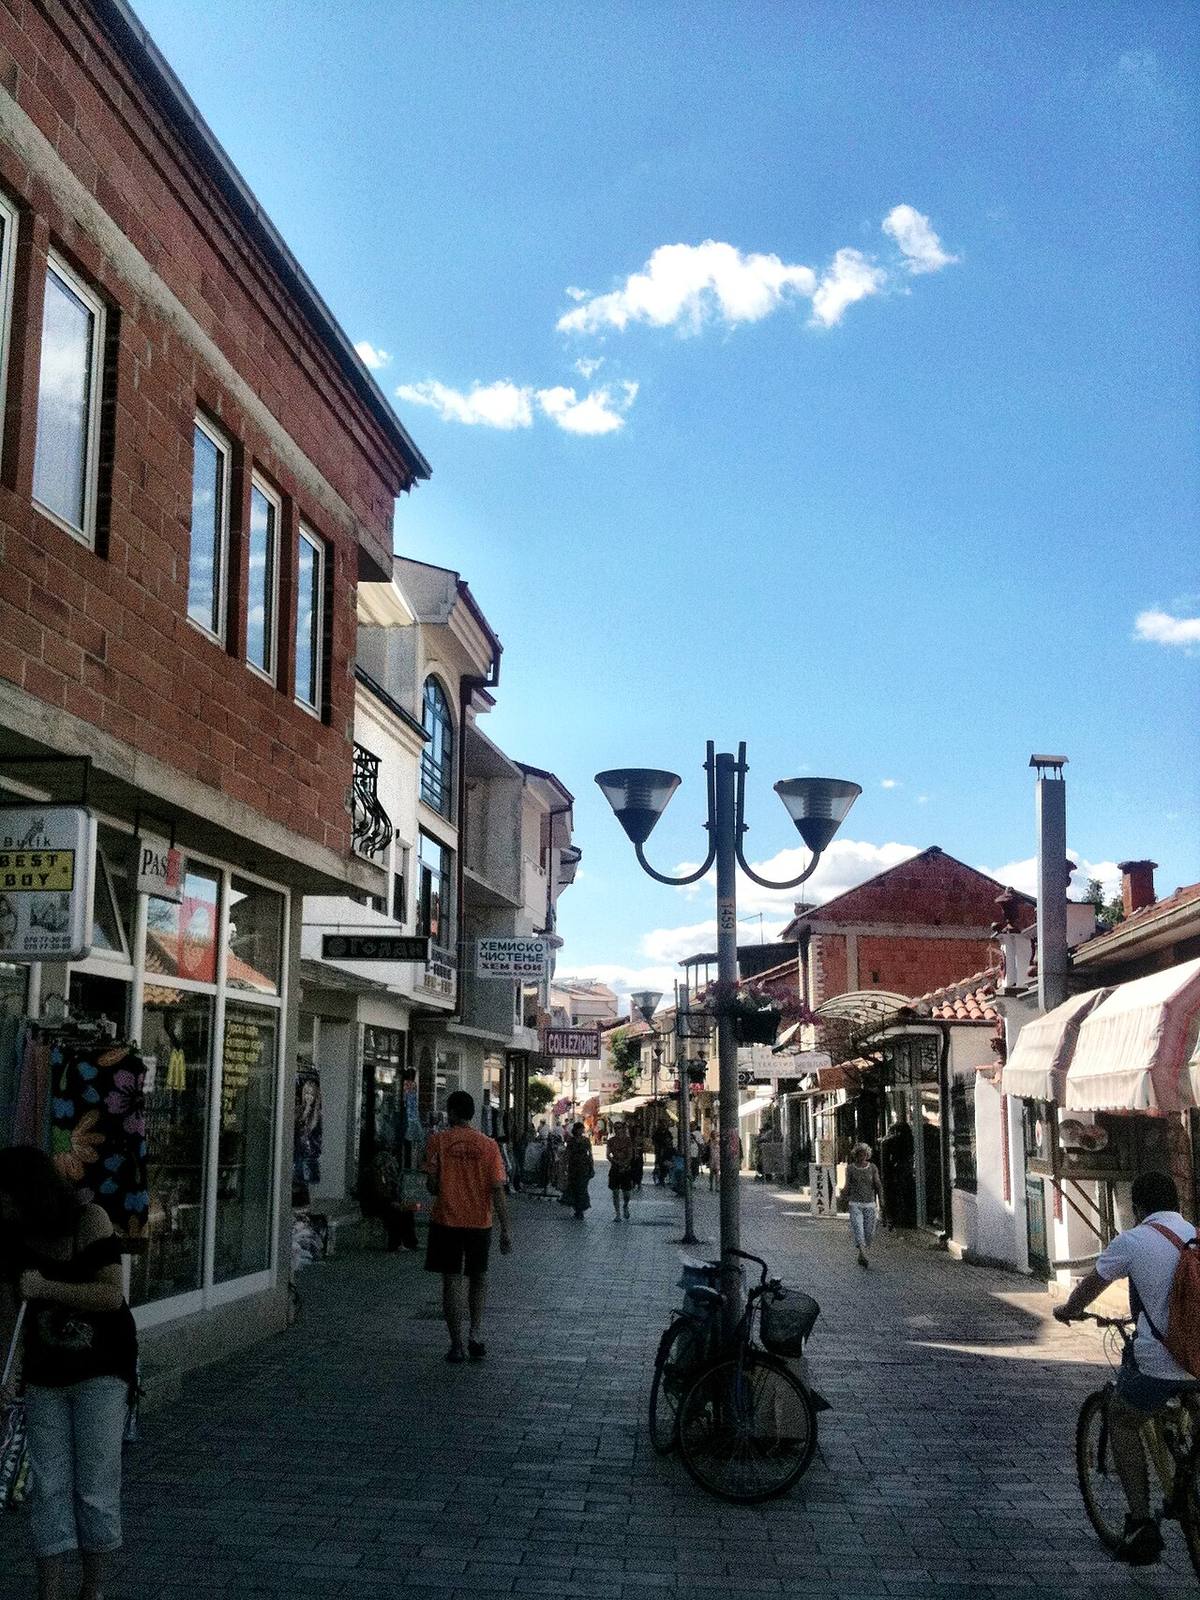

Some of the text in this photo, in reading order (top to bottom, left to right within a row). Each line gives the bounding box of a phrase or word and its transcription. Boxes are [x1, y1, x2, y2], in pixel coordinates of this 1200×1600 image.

[4, 836, 51, 849] Butik
[0, 853, 58, 868] BEST
[480, 941, 544, 953] ХЕМИСКО
[479, 952, 544, 962] ЧИСТЕЊЕ
[481, 962, 510, 970] ХЕМ
[548, 1033, 597, 1056] COLLEZIONE
